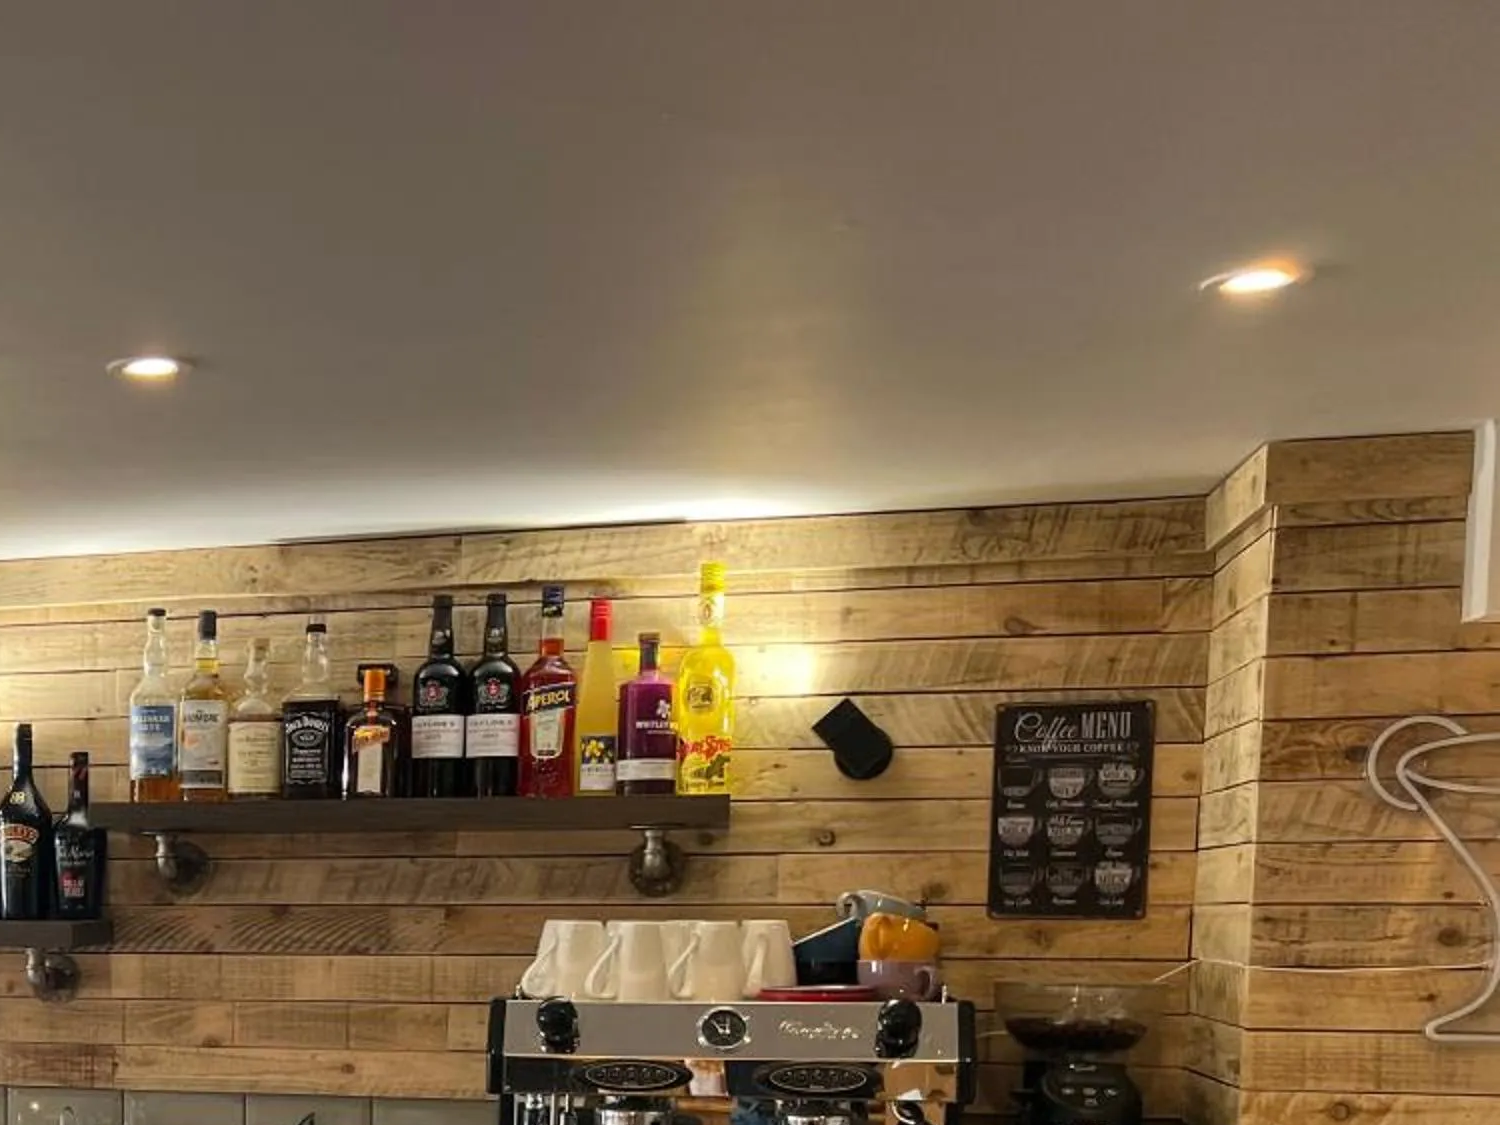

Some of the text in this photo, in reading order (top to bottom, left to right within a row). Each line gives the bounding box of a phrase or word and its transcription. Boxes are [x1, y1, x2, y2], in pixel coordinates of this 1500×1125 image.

[527, 689, 571, 713] APEROL
[1014, 711, 1131, 751] Coffee MENU
